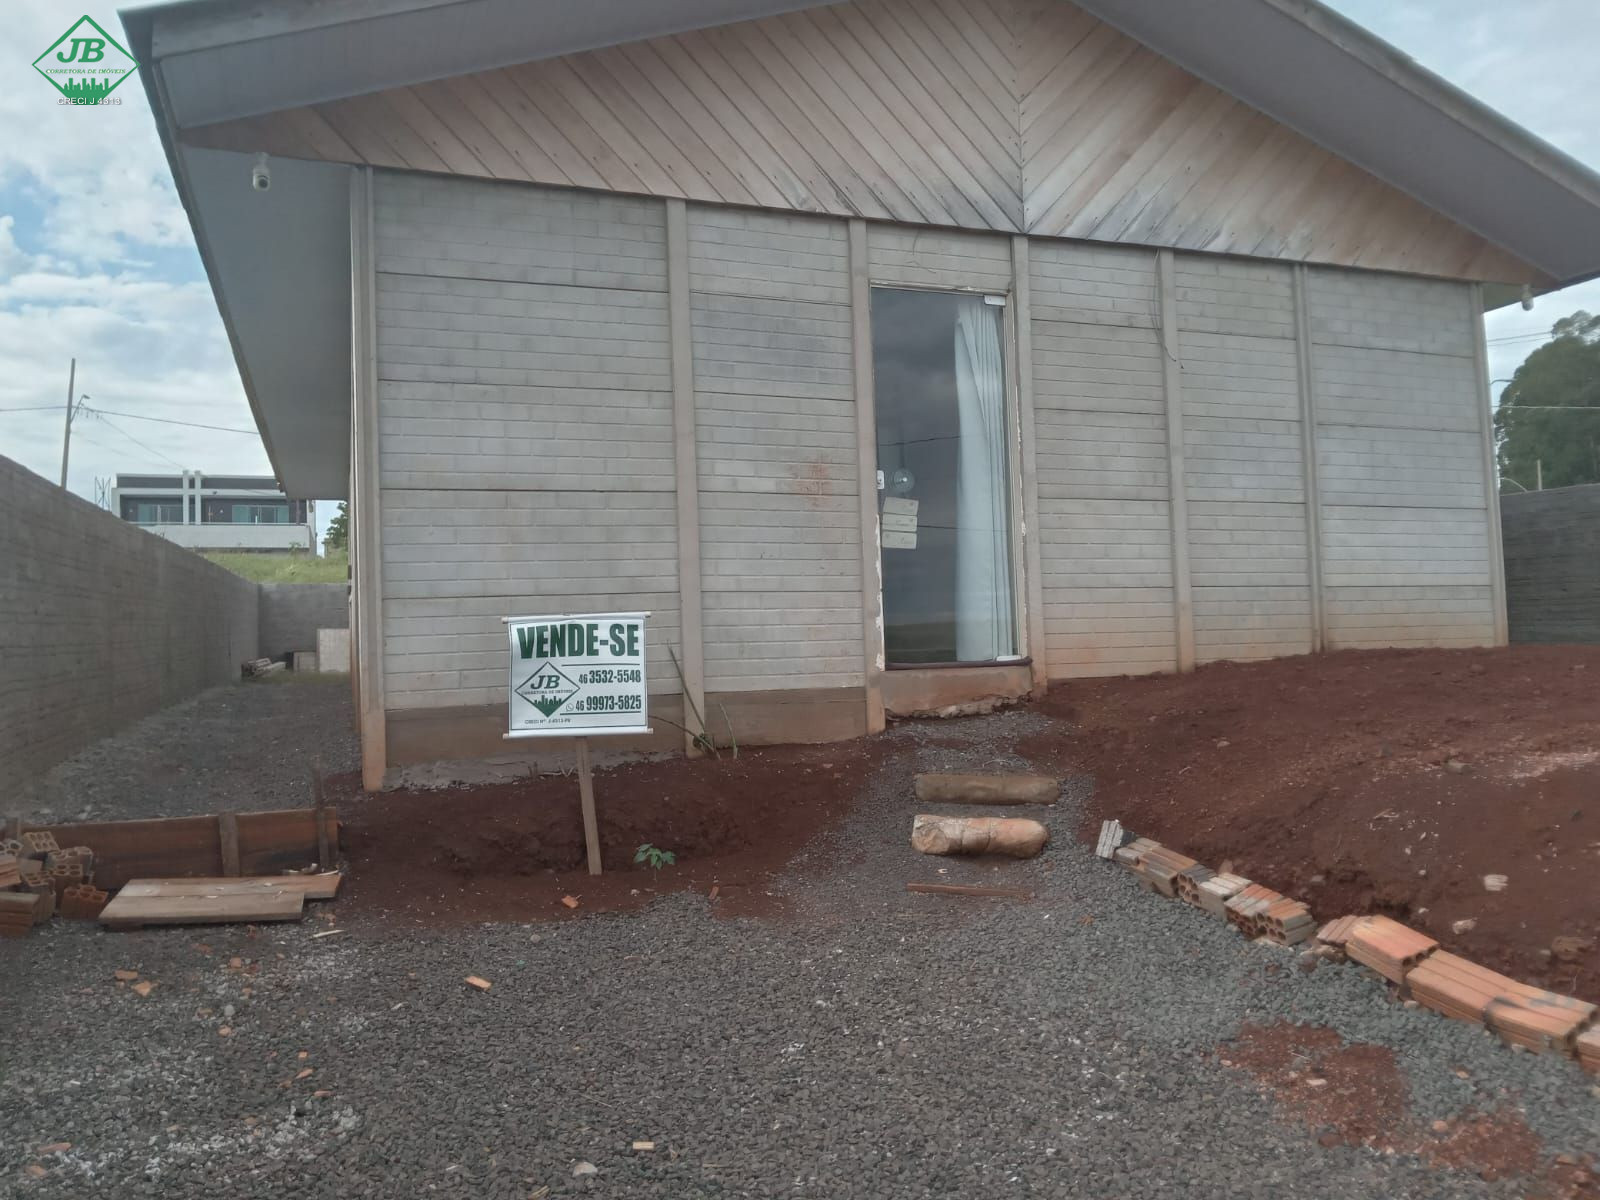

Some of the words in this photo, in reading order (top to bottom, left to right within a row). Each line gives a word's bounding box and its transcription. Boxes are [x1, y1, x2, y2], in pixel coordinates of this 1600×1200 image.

[516, 623, 640, 659] VENDE-SE
[530, 675, 560, 690] JB
[578, 673, 588, 684] 46
[589, 669, 641, 684] 3532-5548
[575, 700, 585, 711] 46
[586, 695, 642, 711] 99973-5825
